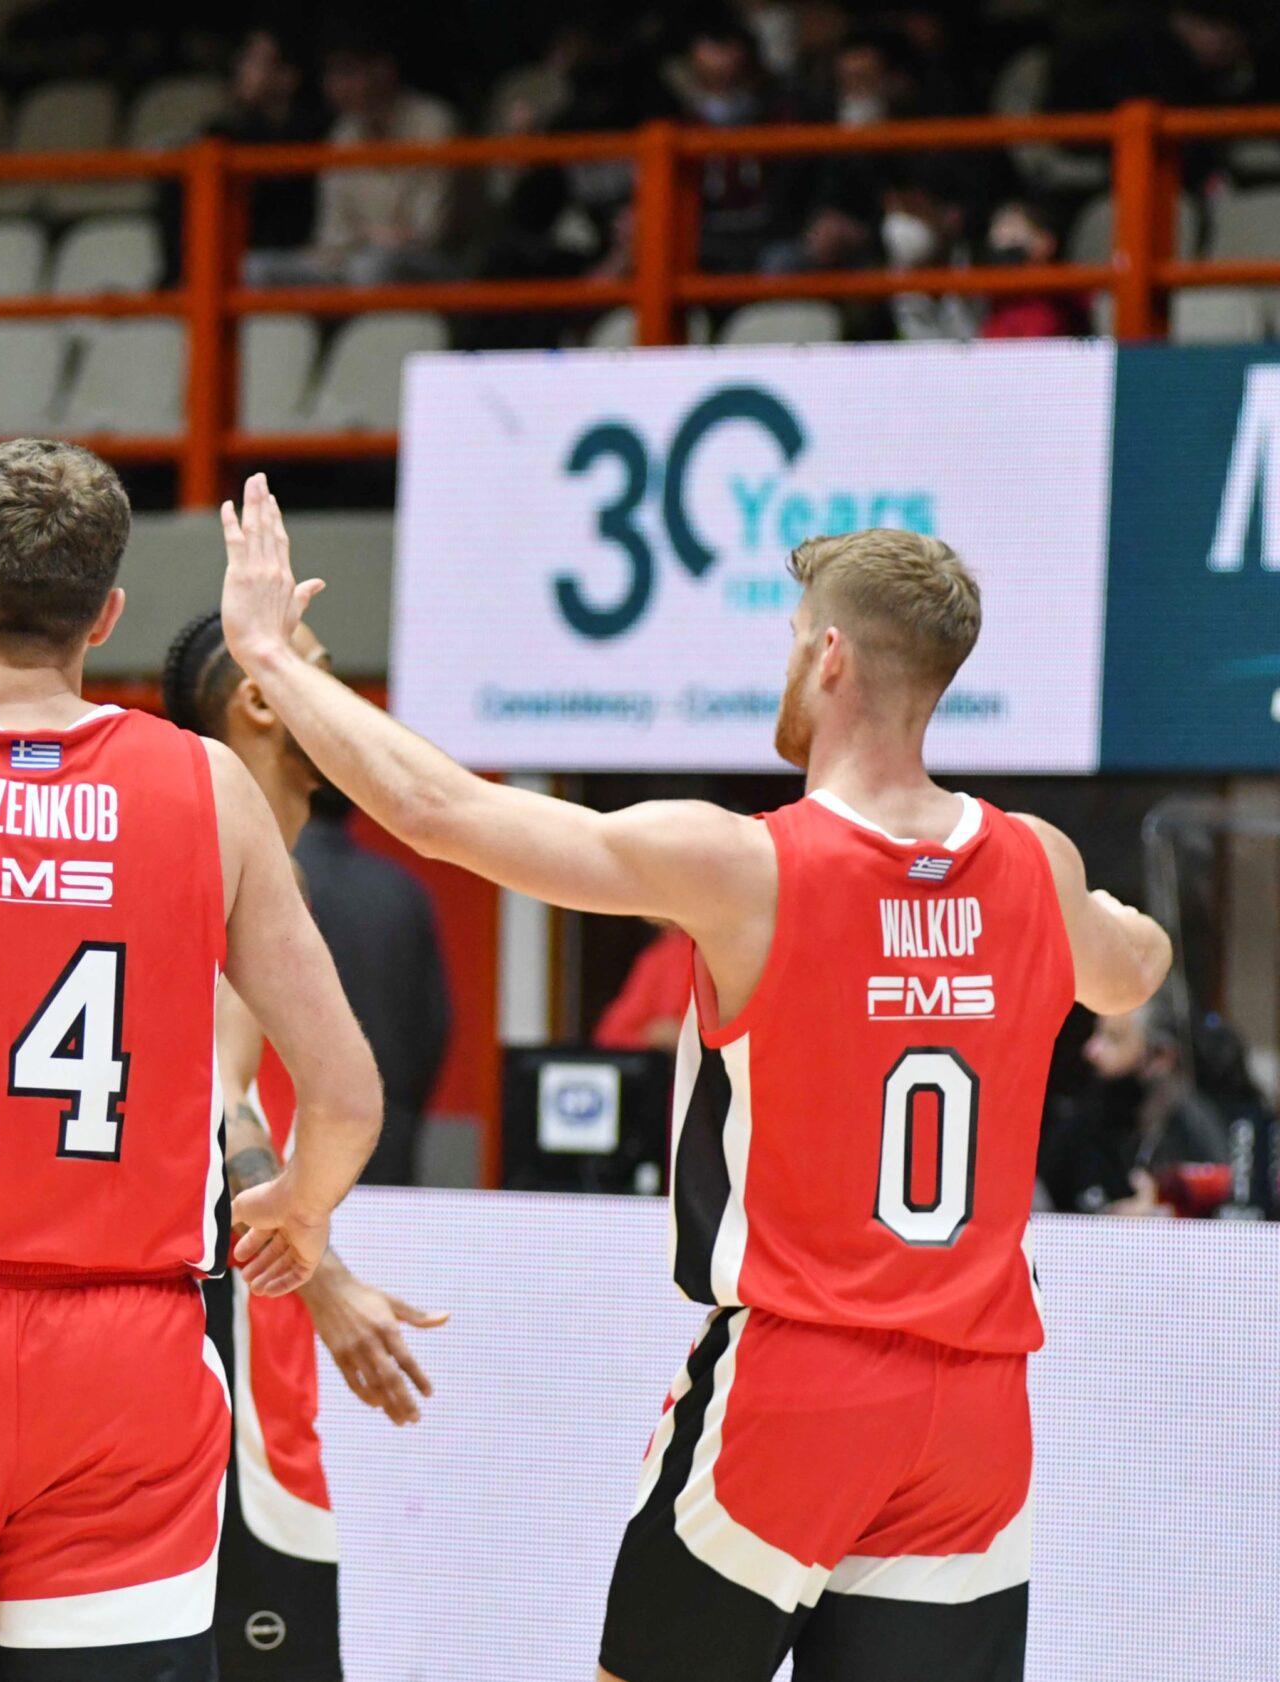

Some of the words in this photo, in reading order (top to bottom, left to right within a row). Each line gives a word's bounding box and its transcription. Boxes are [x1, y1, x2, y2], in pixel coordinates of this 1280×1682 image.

[730, 473, 937, 549] Years
[879, 897, 982, 958] WALKUP
[867, 974, 995, 1016] FMS
[872, 1046, 980, 1247] 0
